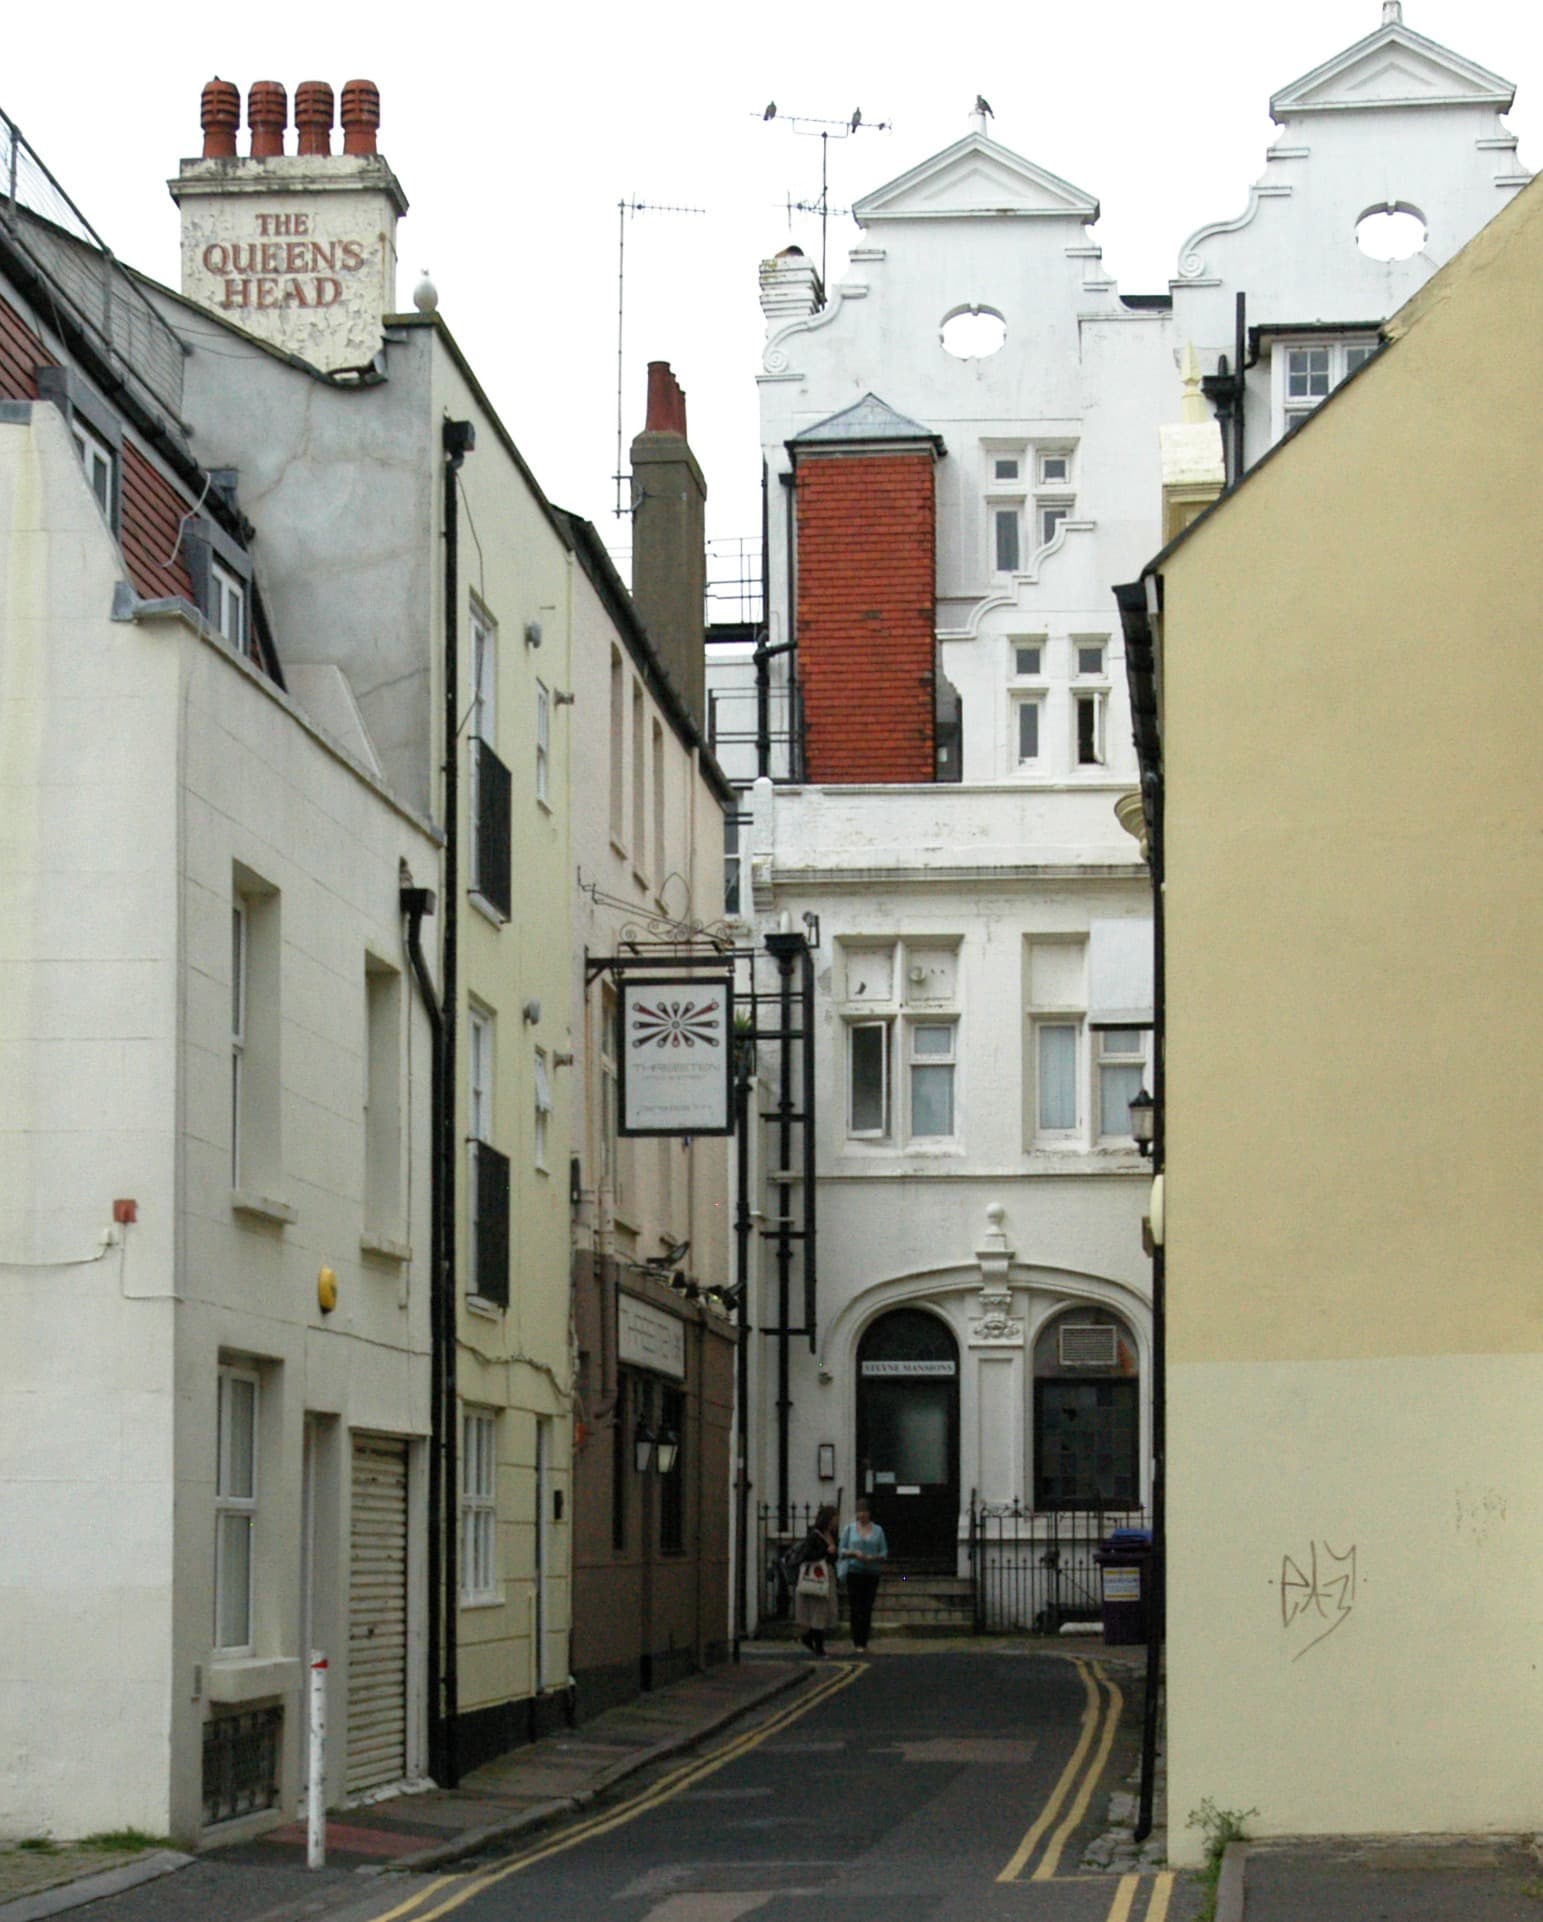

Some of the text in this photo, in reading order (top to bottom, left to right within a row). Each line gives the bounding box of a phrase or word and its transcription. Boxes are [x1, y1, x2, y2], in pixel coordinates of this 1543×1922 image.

[256, 213, 309, 237] THE
[203, 240, 364, 276] QUEEN'S
[221, 277, 343, 311] HEAD
